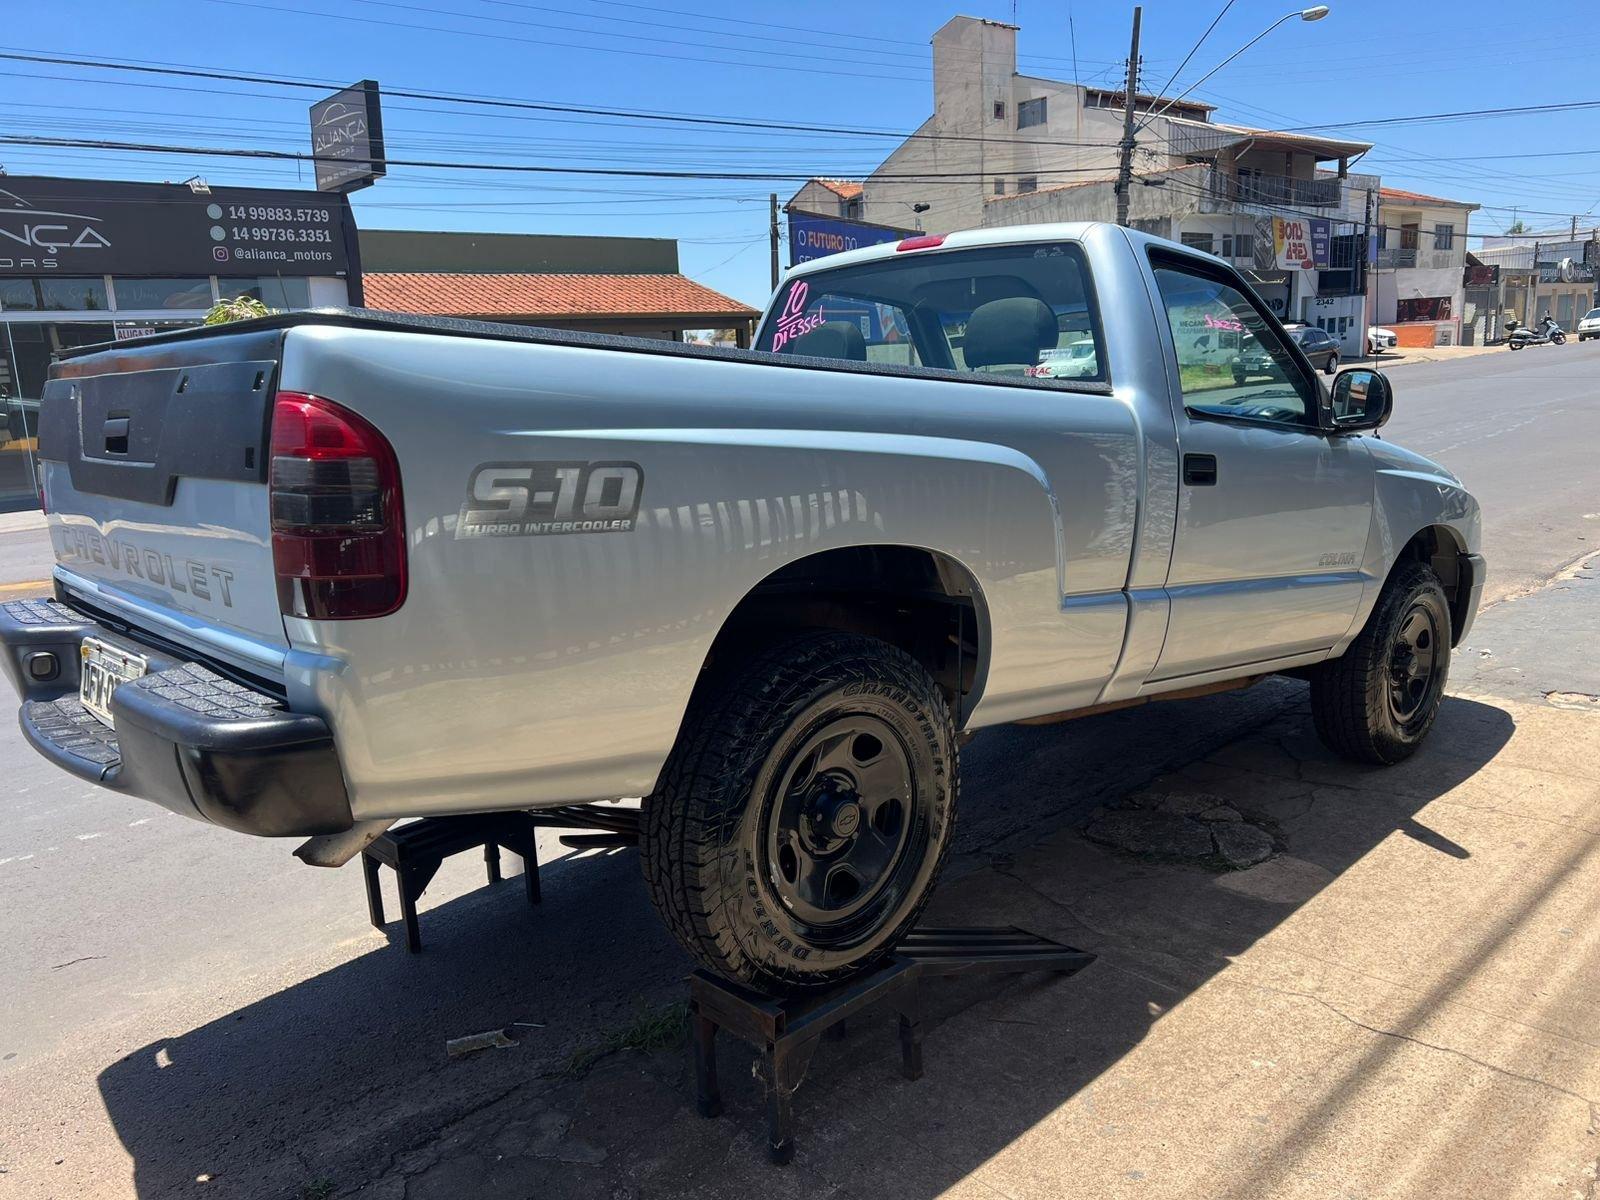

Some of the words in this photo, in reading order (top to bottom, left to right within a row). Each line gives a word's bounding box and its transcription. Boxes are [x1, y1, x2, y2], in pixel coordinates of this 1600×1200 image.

[315, 119, 366, 152] ALIANÇA
[228, 206, 246, 220] 14
[248, 206, 330, 222] 99883.5739
[232, 226, 249, 241] 14
[251, 227, 332, 242] 99736.3351
[798, 229, 807, 246] O
[808, 231, 844, 251] FUTURO
[234, 247, 333, 262] @alianca_motors
[776, 279, 809, 323] 10
[464, 465, 641, 523] S-10
[463, 523, 521, 535] TURBO
[524, 519, 632, 534] INTERCOOLER
[62, 525, 234, 608] CHEVROLET
